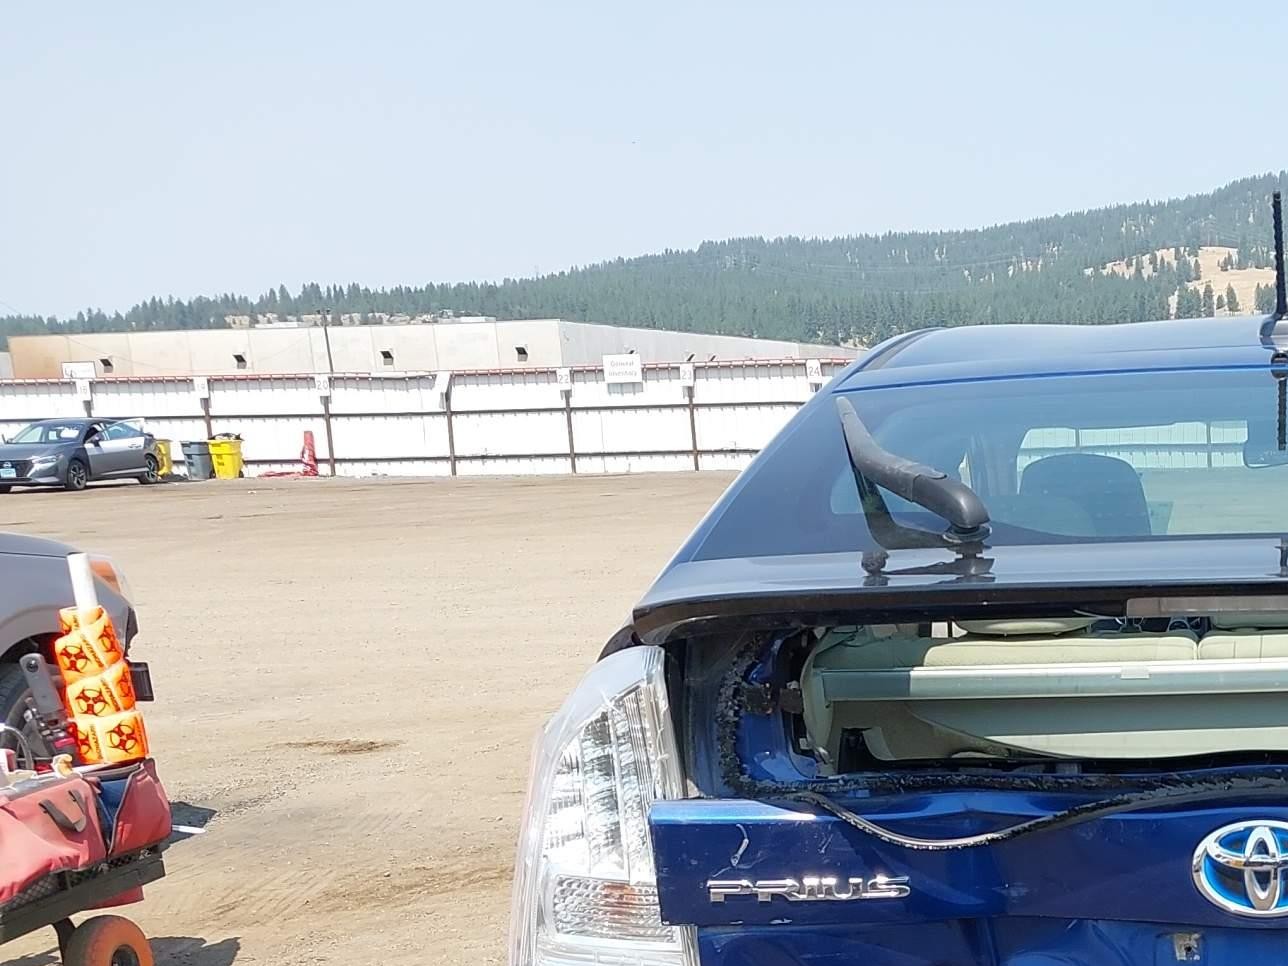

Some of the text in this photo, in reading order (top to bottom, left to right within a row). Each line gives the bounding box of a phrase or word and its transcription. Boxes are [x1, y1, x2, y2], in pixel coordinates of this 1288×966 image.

[808, 365, 821, 376] 24
[316, 379, 329, 390] 20
[559, 374, 569, 384] 22
[706, 876, 911, 902] PRIUS
